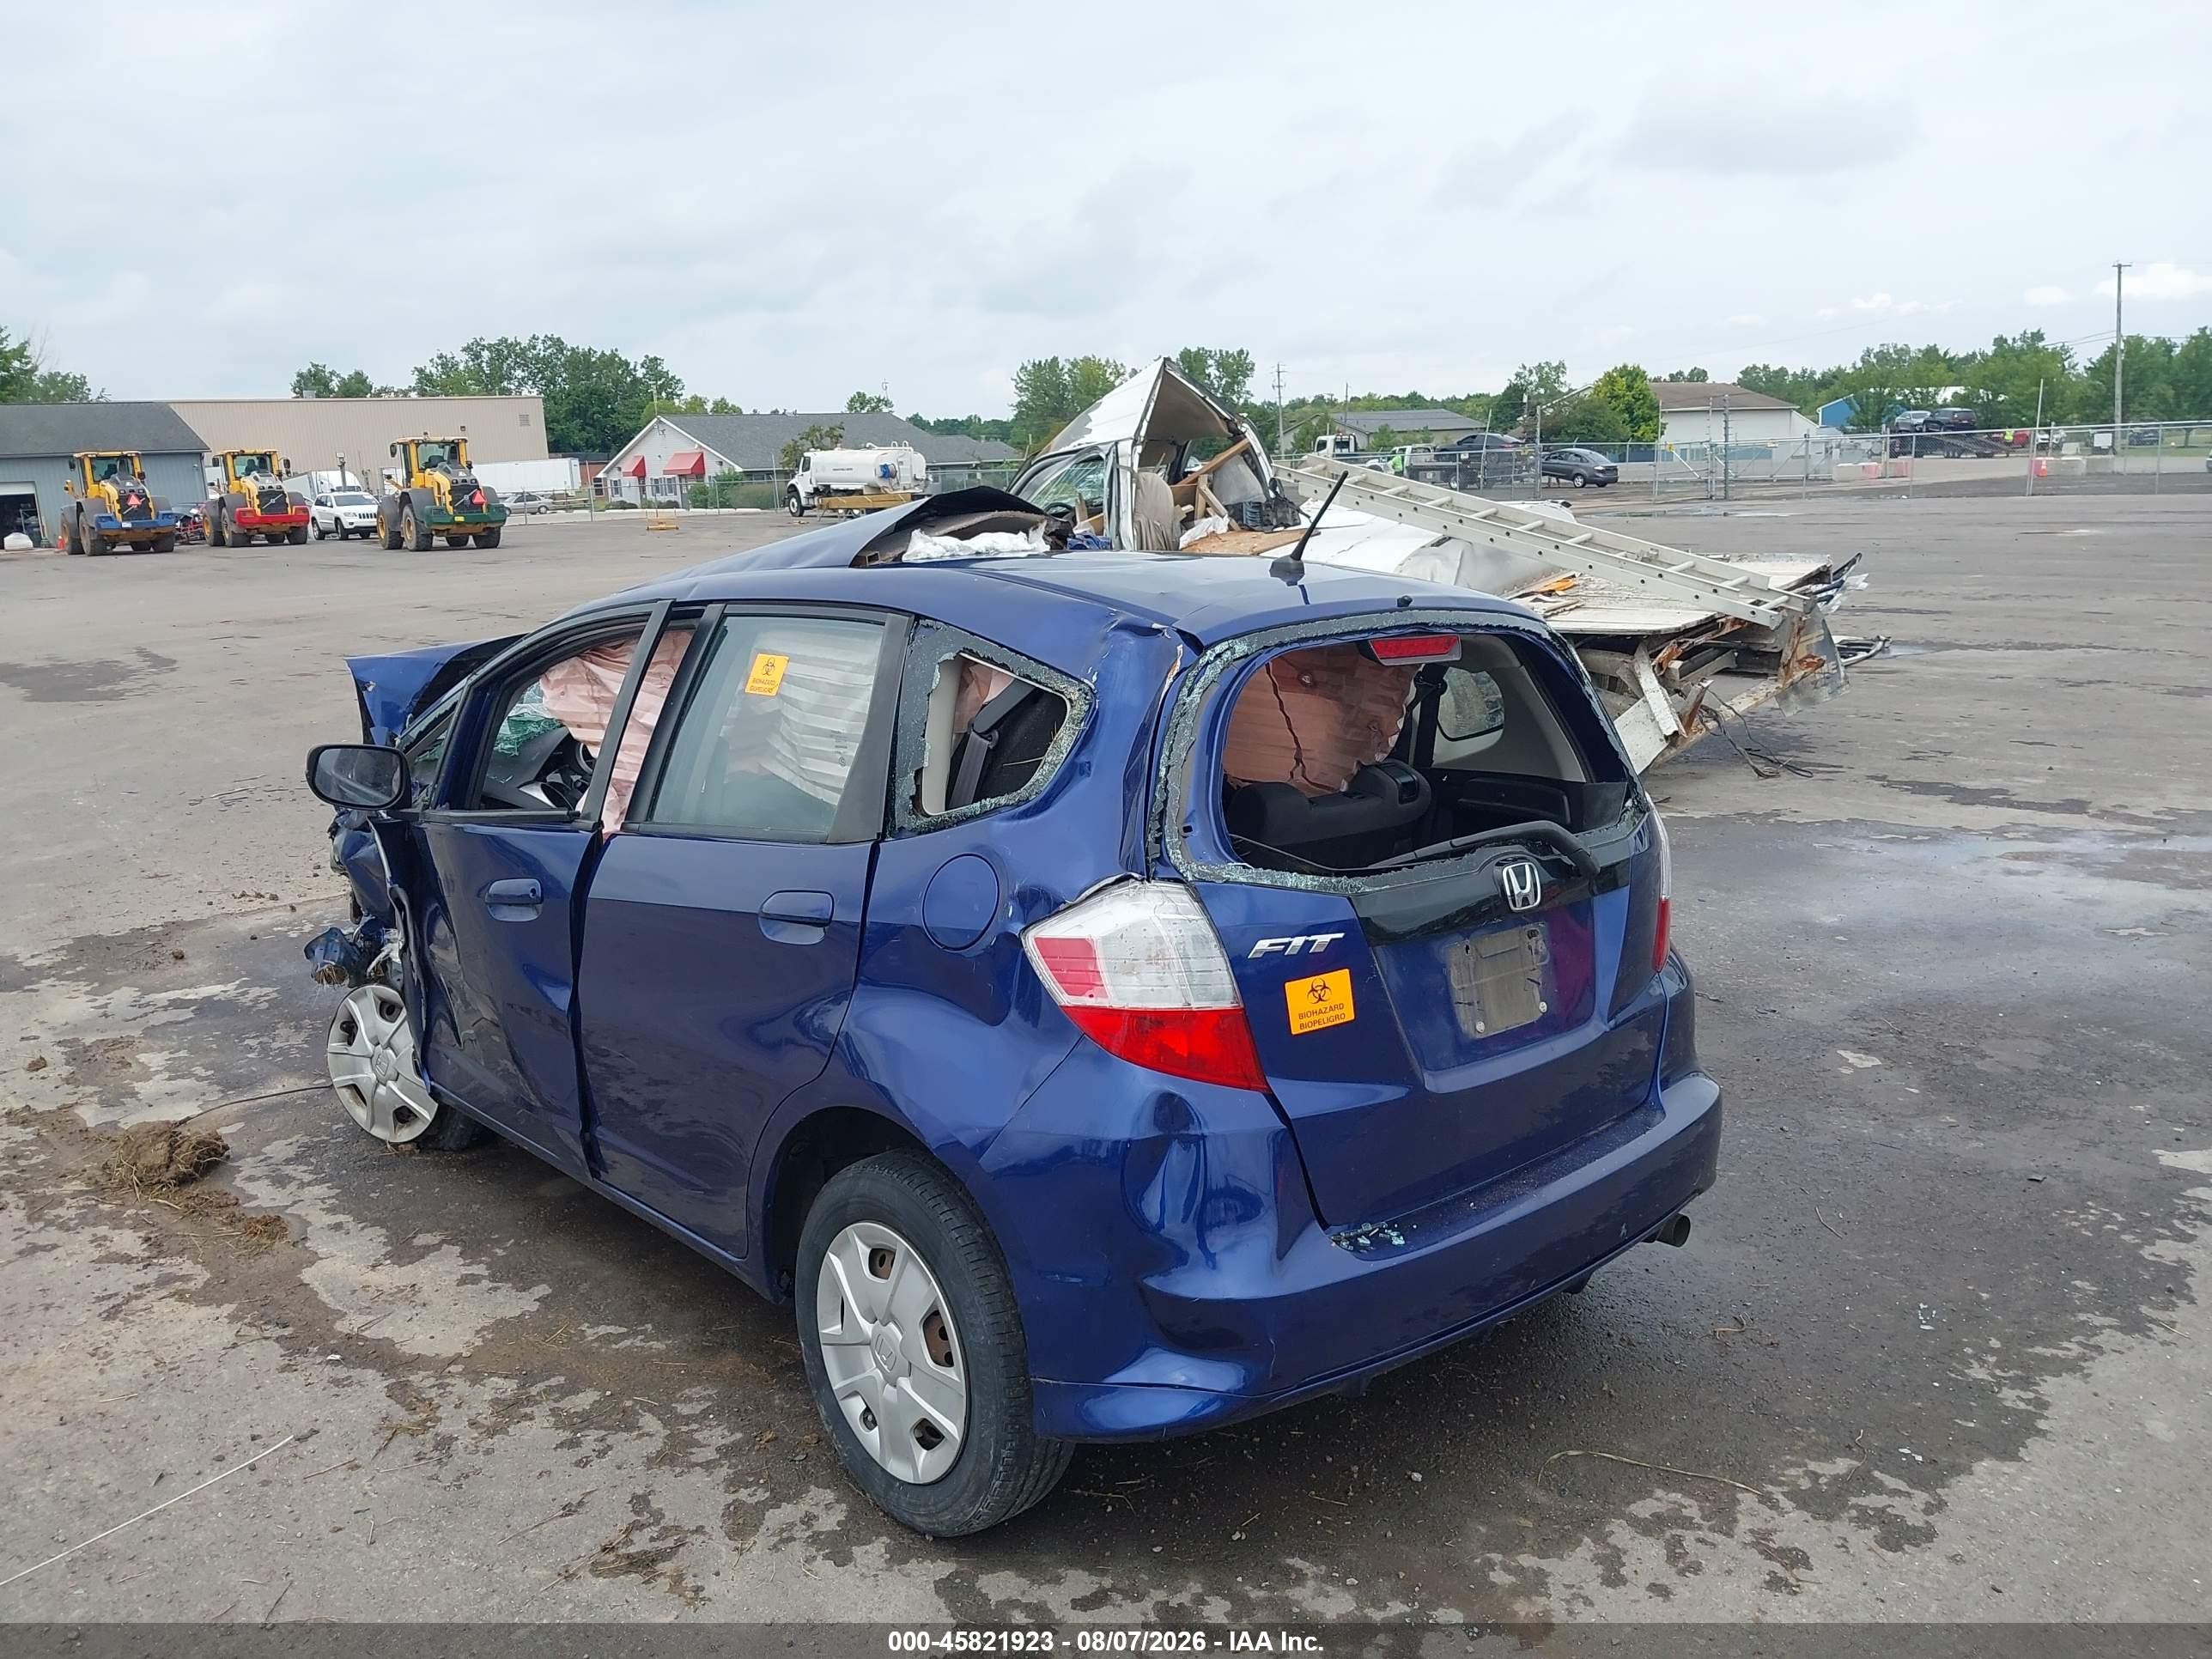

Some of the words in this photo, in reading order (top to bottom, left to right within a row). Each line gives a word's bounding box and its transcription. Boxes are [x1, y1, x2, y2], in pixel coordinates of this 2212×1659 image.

[1248, 933, 1346, 958] FIT
[1298, 1002, 1345, 1020] BIOHAZARD
[1299, 1012, 1346, 1030] BIOPELIGRO
